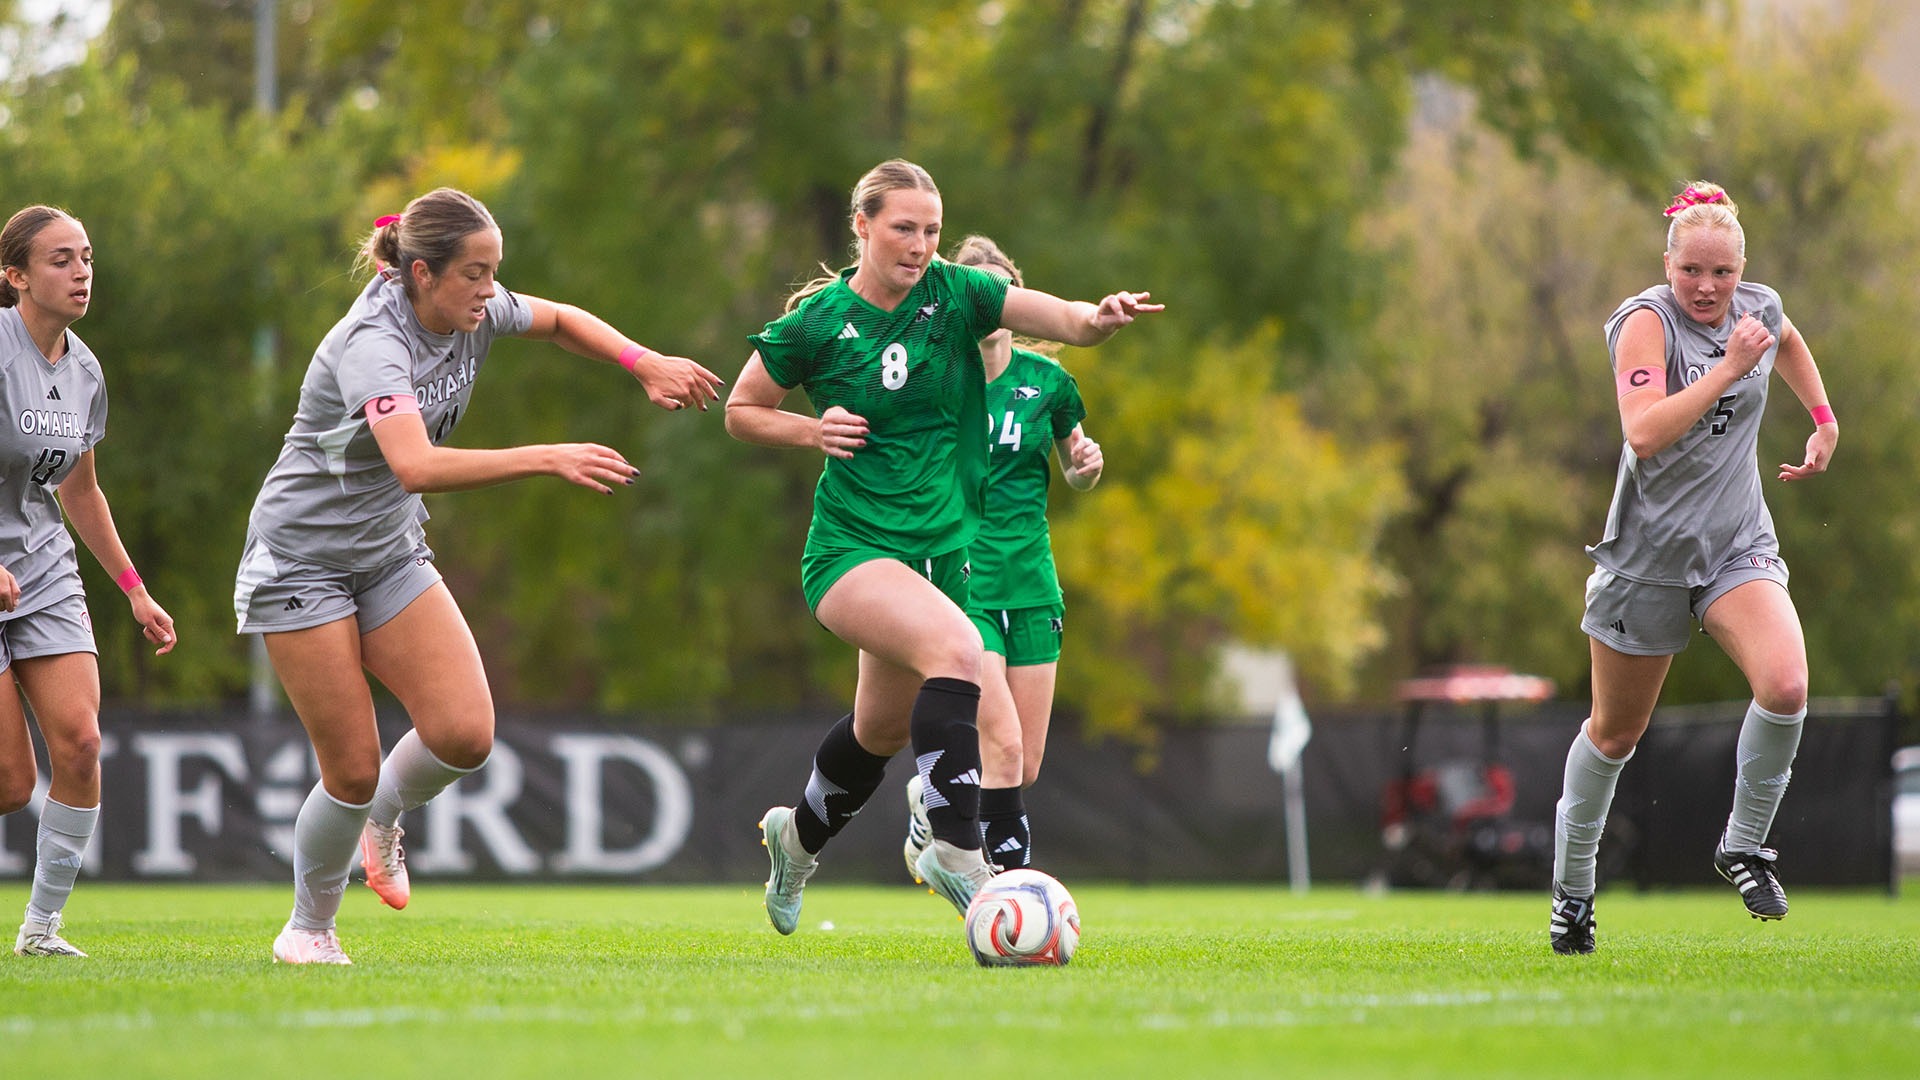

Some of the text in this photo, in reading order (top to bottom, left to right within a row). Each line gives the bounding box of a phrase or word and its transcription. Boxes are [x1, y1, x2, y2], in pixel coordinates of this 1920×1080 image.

[881, 342, 909, 391] 8
[1630, 369, 1650, 387] C
[376, 395, 396, 415] C
[1710, 393, 1738, 437] 5
[19, 408, 84, 439] OMAHA
